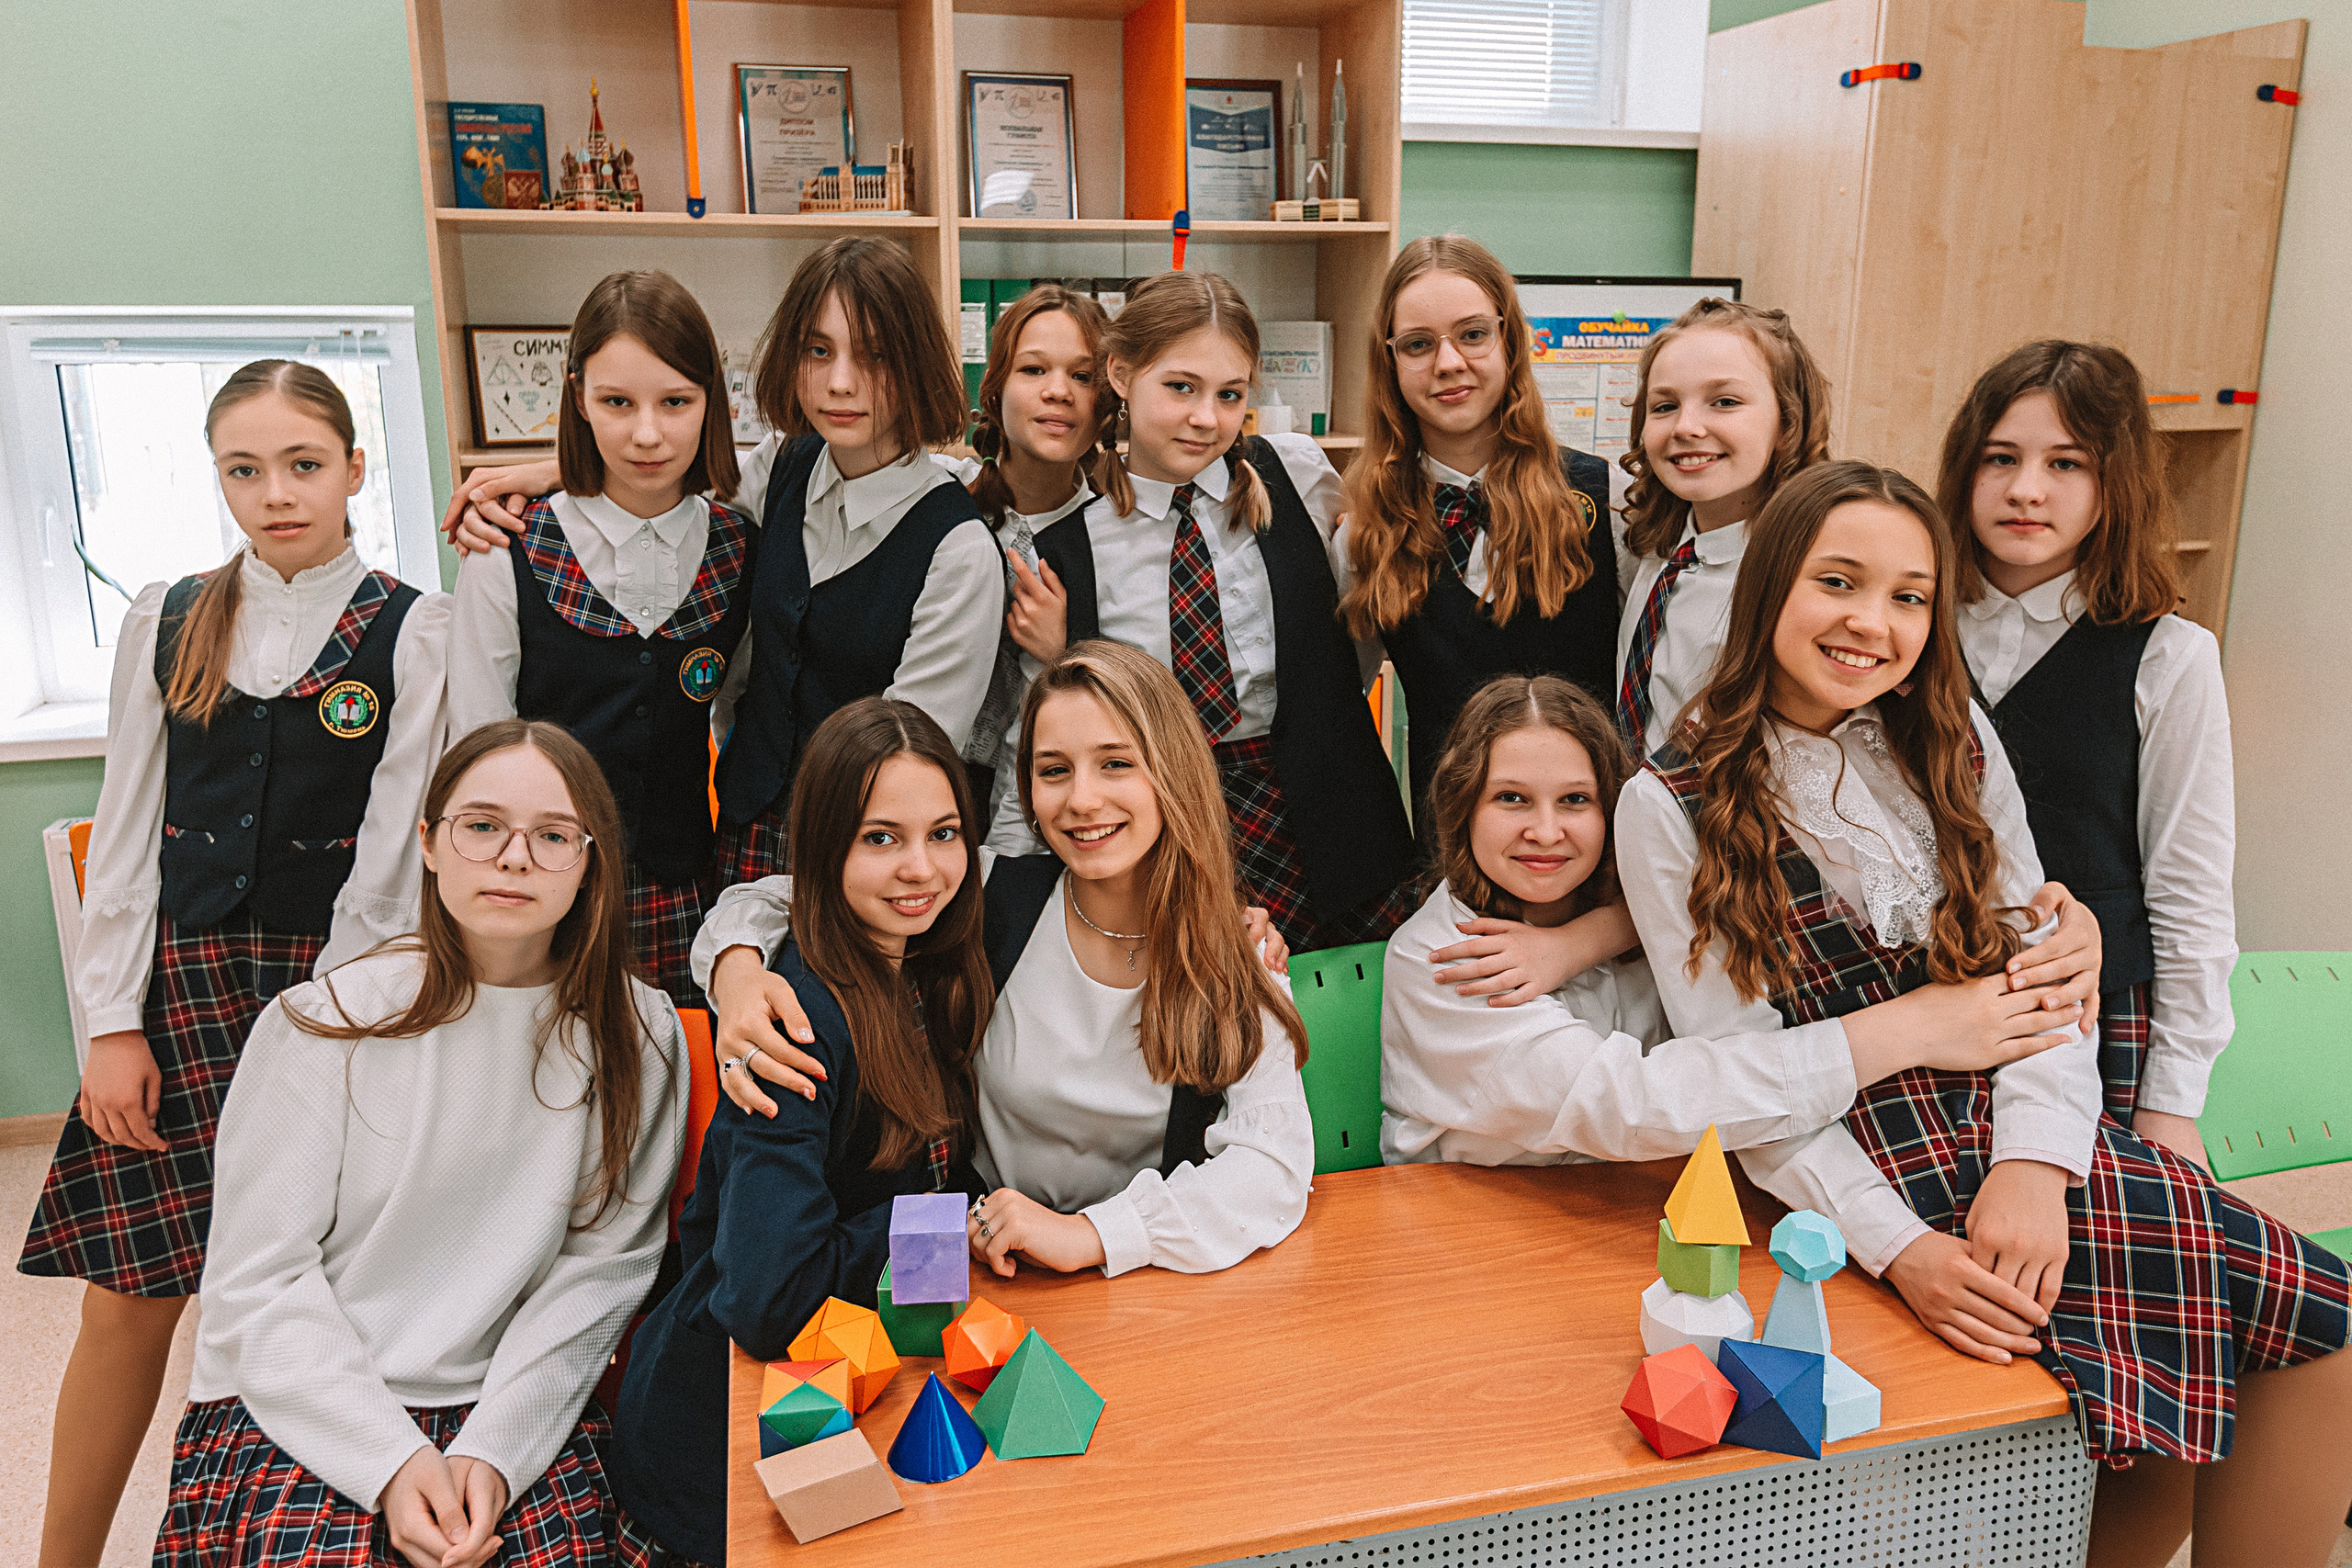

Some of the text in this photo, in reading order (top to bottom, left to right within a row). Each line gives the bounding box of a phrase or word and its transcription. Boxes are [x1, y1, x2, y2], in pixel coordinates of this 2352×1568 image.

[1578, 320, 1650, 333] ОБУЧАЙКА
[1533, 330, 1552, 357] 5
[323, 685, 362, 708] ГИМНАЗИЯ
